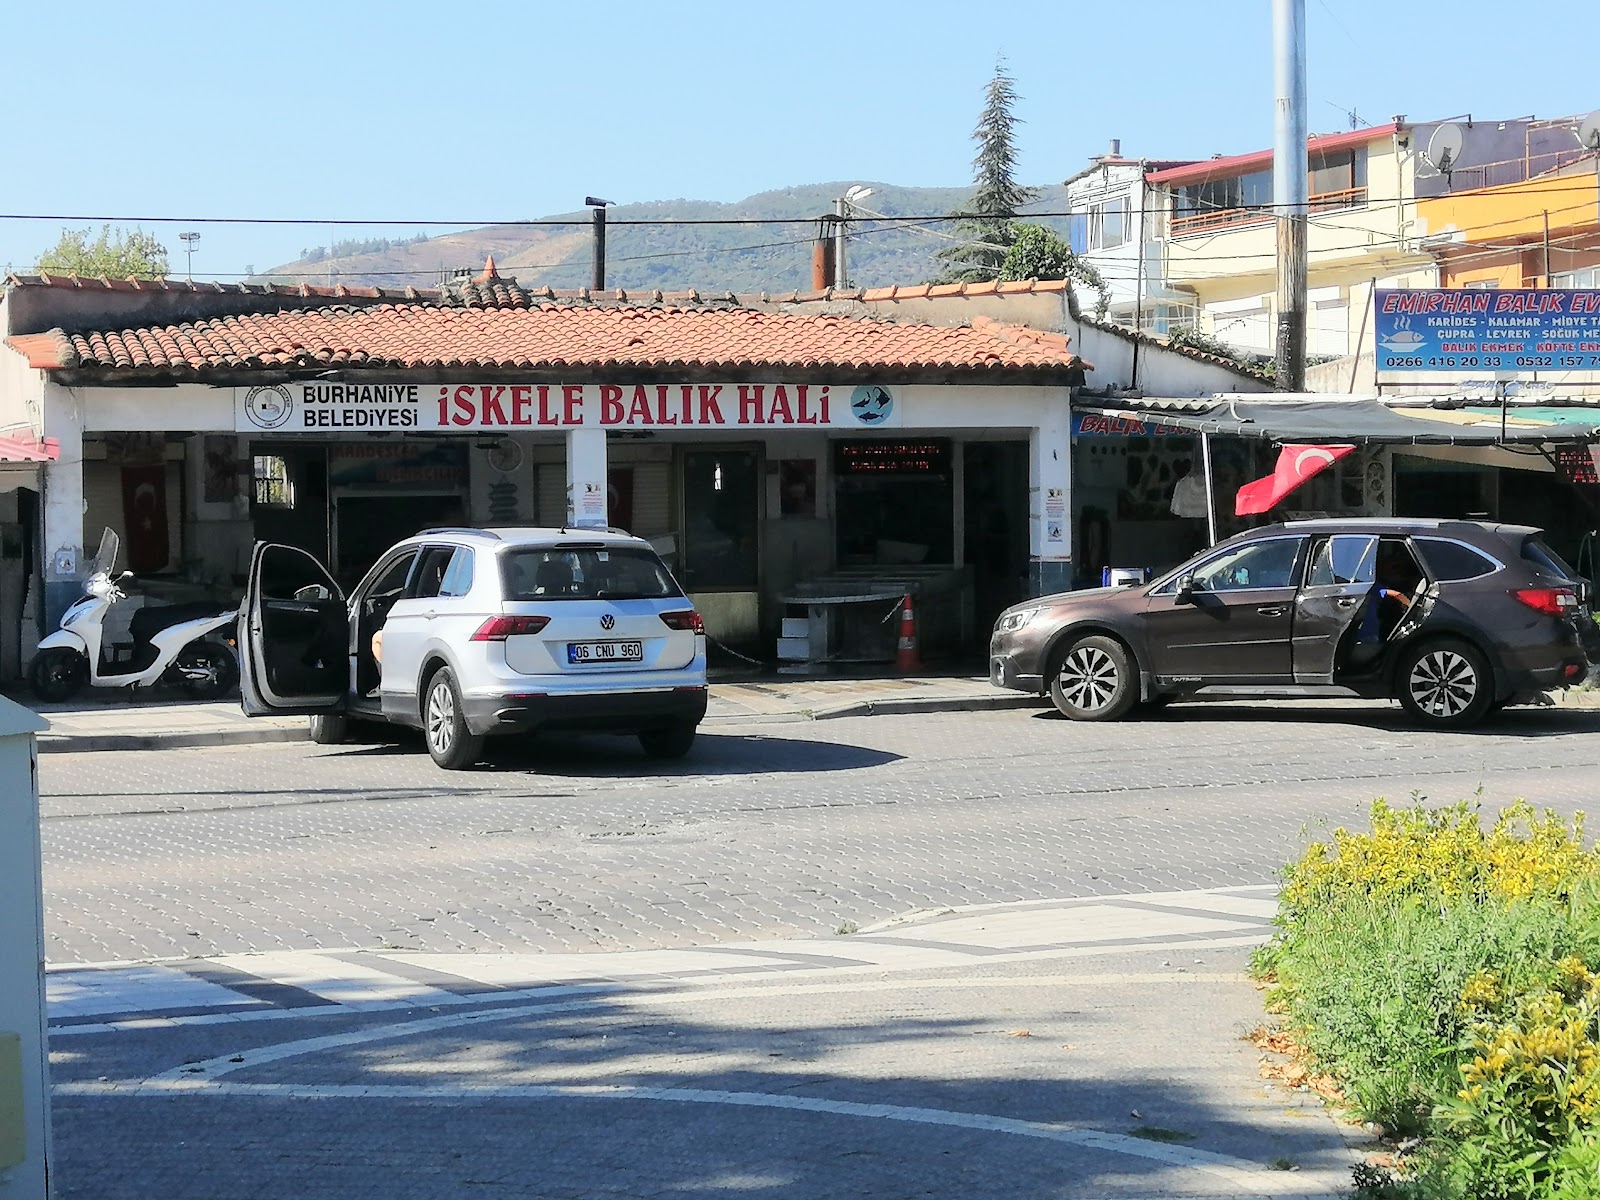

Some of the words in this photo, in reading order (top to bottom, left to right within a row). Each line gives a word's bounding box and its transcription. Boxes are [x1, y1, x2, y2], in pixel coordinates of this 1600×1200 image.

[1494, 293, 1565, 314] BALIK
[1427, 315, 1477, 327] KARİDES
[1488, 317, 1540, 327] KALAMAR
[1552, 315, 1587, 327] MİDYE
[1437, 329, 1475, 340] ÇUPRA
[1486, 329, 1531, 339] LEVREK
[1542, 327, 1579, 339] SOĞUK
[1442, 342, 1477, 353] BALIK
[1481, 342, 1524, 353] EKMEK
[1536, 340, 1576, 353] KÖFTE
[1386, 356, 1423, 367] 0266
[1428, 356, 1456, 367] 416
[1460, 356, 1478, 367] 20
[1483, 356, 1501, 367] 33
[1516, 356, 1552, 367] 0532
[1560, 356, 1584, 367] 157
[600, 385, 725, 425] BALIK
[1079, 414, 1146, 436] BALIK
[576, 646, 589, 658] 06
[621, 644, 640, 656] 960
